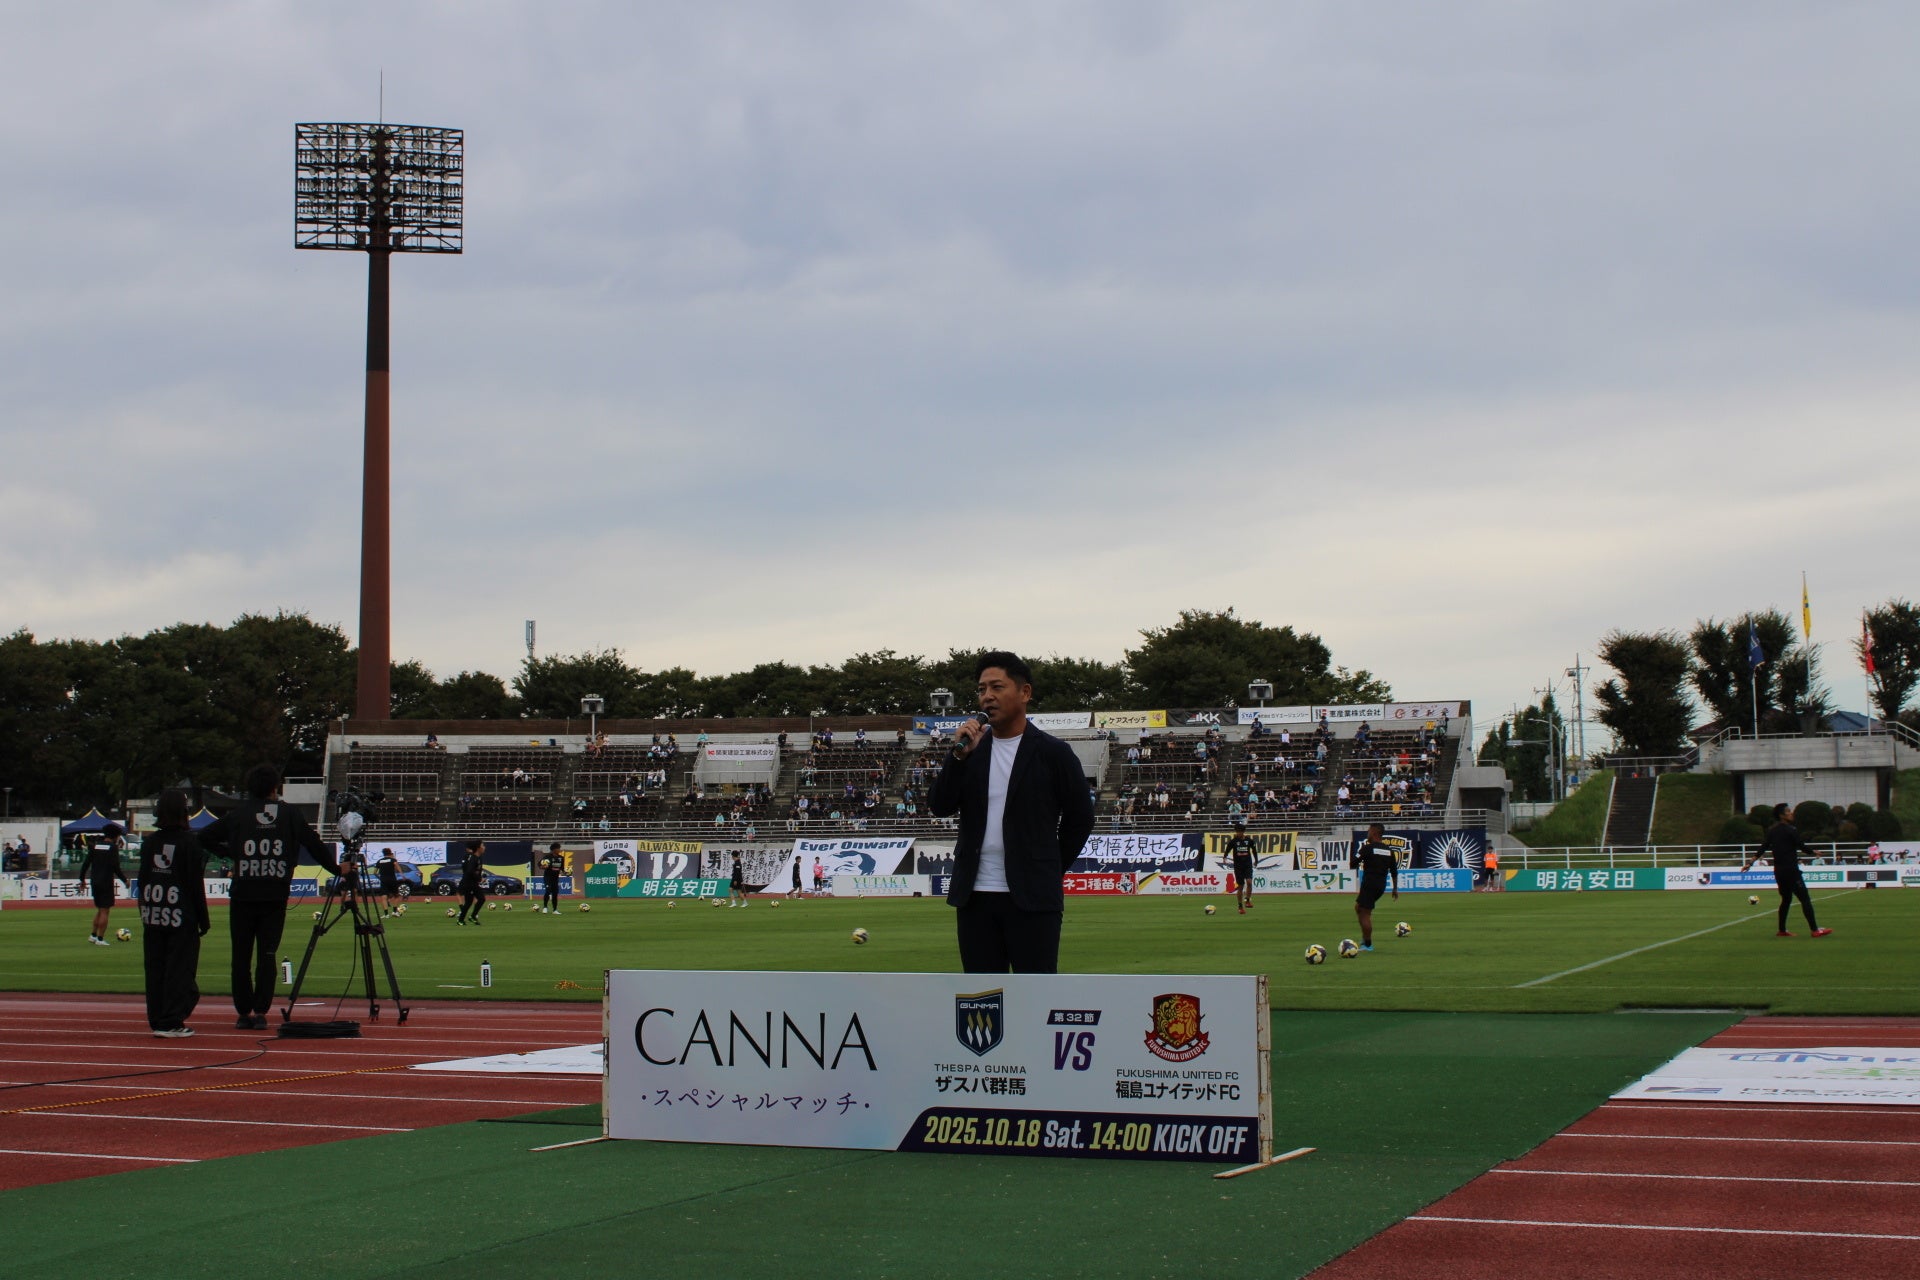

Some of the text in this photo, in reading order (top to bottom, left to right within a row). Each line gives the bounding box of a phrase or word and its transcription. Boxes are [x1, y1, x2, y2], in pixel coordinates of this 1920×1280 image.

[934, 721, 966, 730] RESPEC
[1108, 716, 1147, 725] ケアスイッチ
[244, 838, 283, 856] 003
[603, 841, 629, 850] Gunma
[640, 842, 698, 853] ALWAYS ON
[800, 840, 909, 852] Ever Onward
[1210, 833, 1292, 853] TRMPH
[1321, 841, 1349, 862] WAY
[1299, 848, 1318, 870] 12
[1882, 849, 1920, 863] スポー
[239, 859, 287, 878] PRESS
[650, 852, 688, 880] 12
[586, 876, 617, 885] 明治安田
[853, 876, 908, 886] YUTAKA
[1063, 877, 1115, 891] ネコ種苗
[1158, 874, 1220, 886] Yakult
[1269, 873, 1351, 890] 株式会社 ヤマト
[1537, 870, 1634, 890] 明治安田
[1667, 874, 1693, 882] 2025
[642, 879, 718, 897] 明治安田
[960, 1002, 999, 1010] GUNMA
[634, 1007, 878, 1071] CANNA
[1053, 1031, 1096, 1071] VS
[1147, 1039, 1208, 1060] FUKUSHIMA UNITED FC
[934, 1063, 1027, 1074] THESPA GUNMA
[1116, 1069, 1239, 1081] FUKUSHIMA UNITED FC
[935, 1075, 1026, 1096] ザスパ群馬
[1115, 1080, 1240, 1101] 福島ユナイテッドFC
[923, 1115, 1249, 1155] 2025.10.18 Sat. 14:00 KICK OFF
